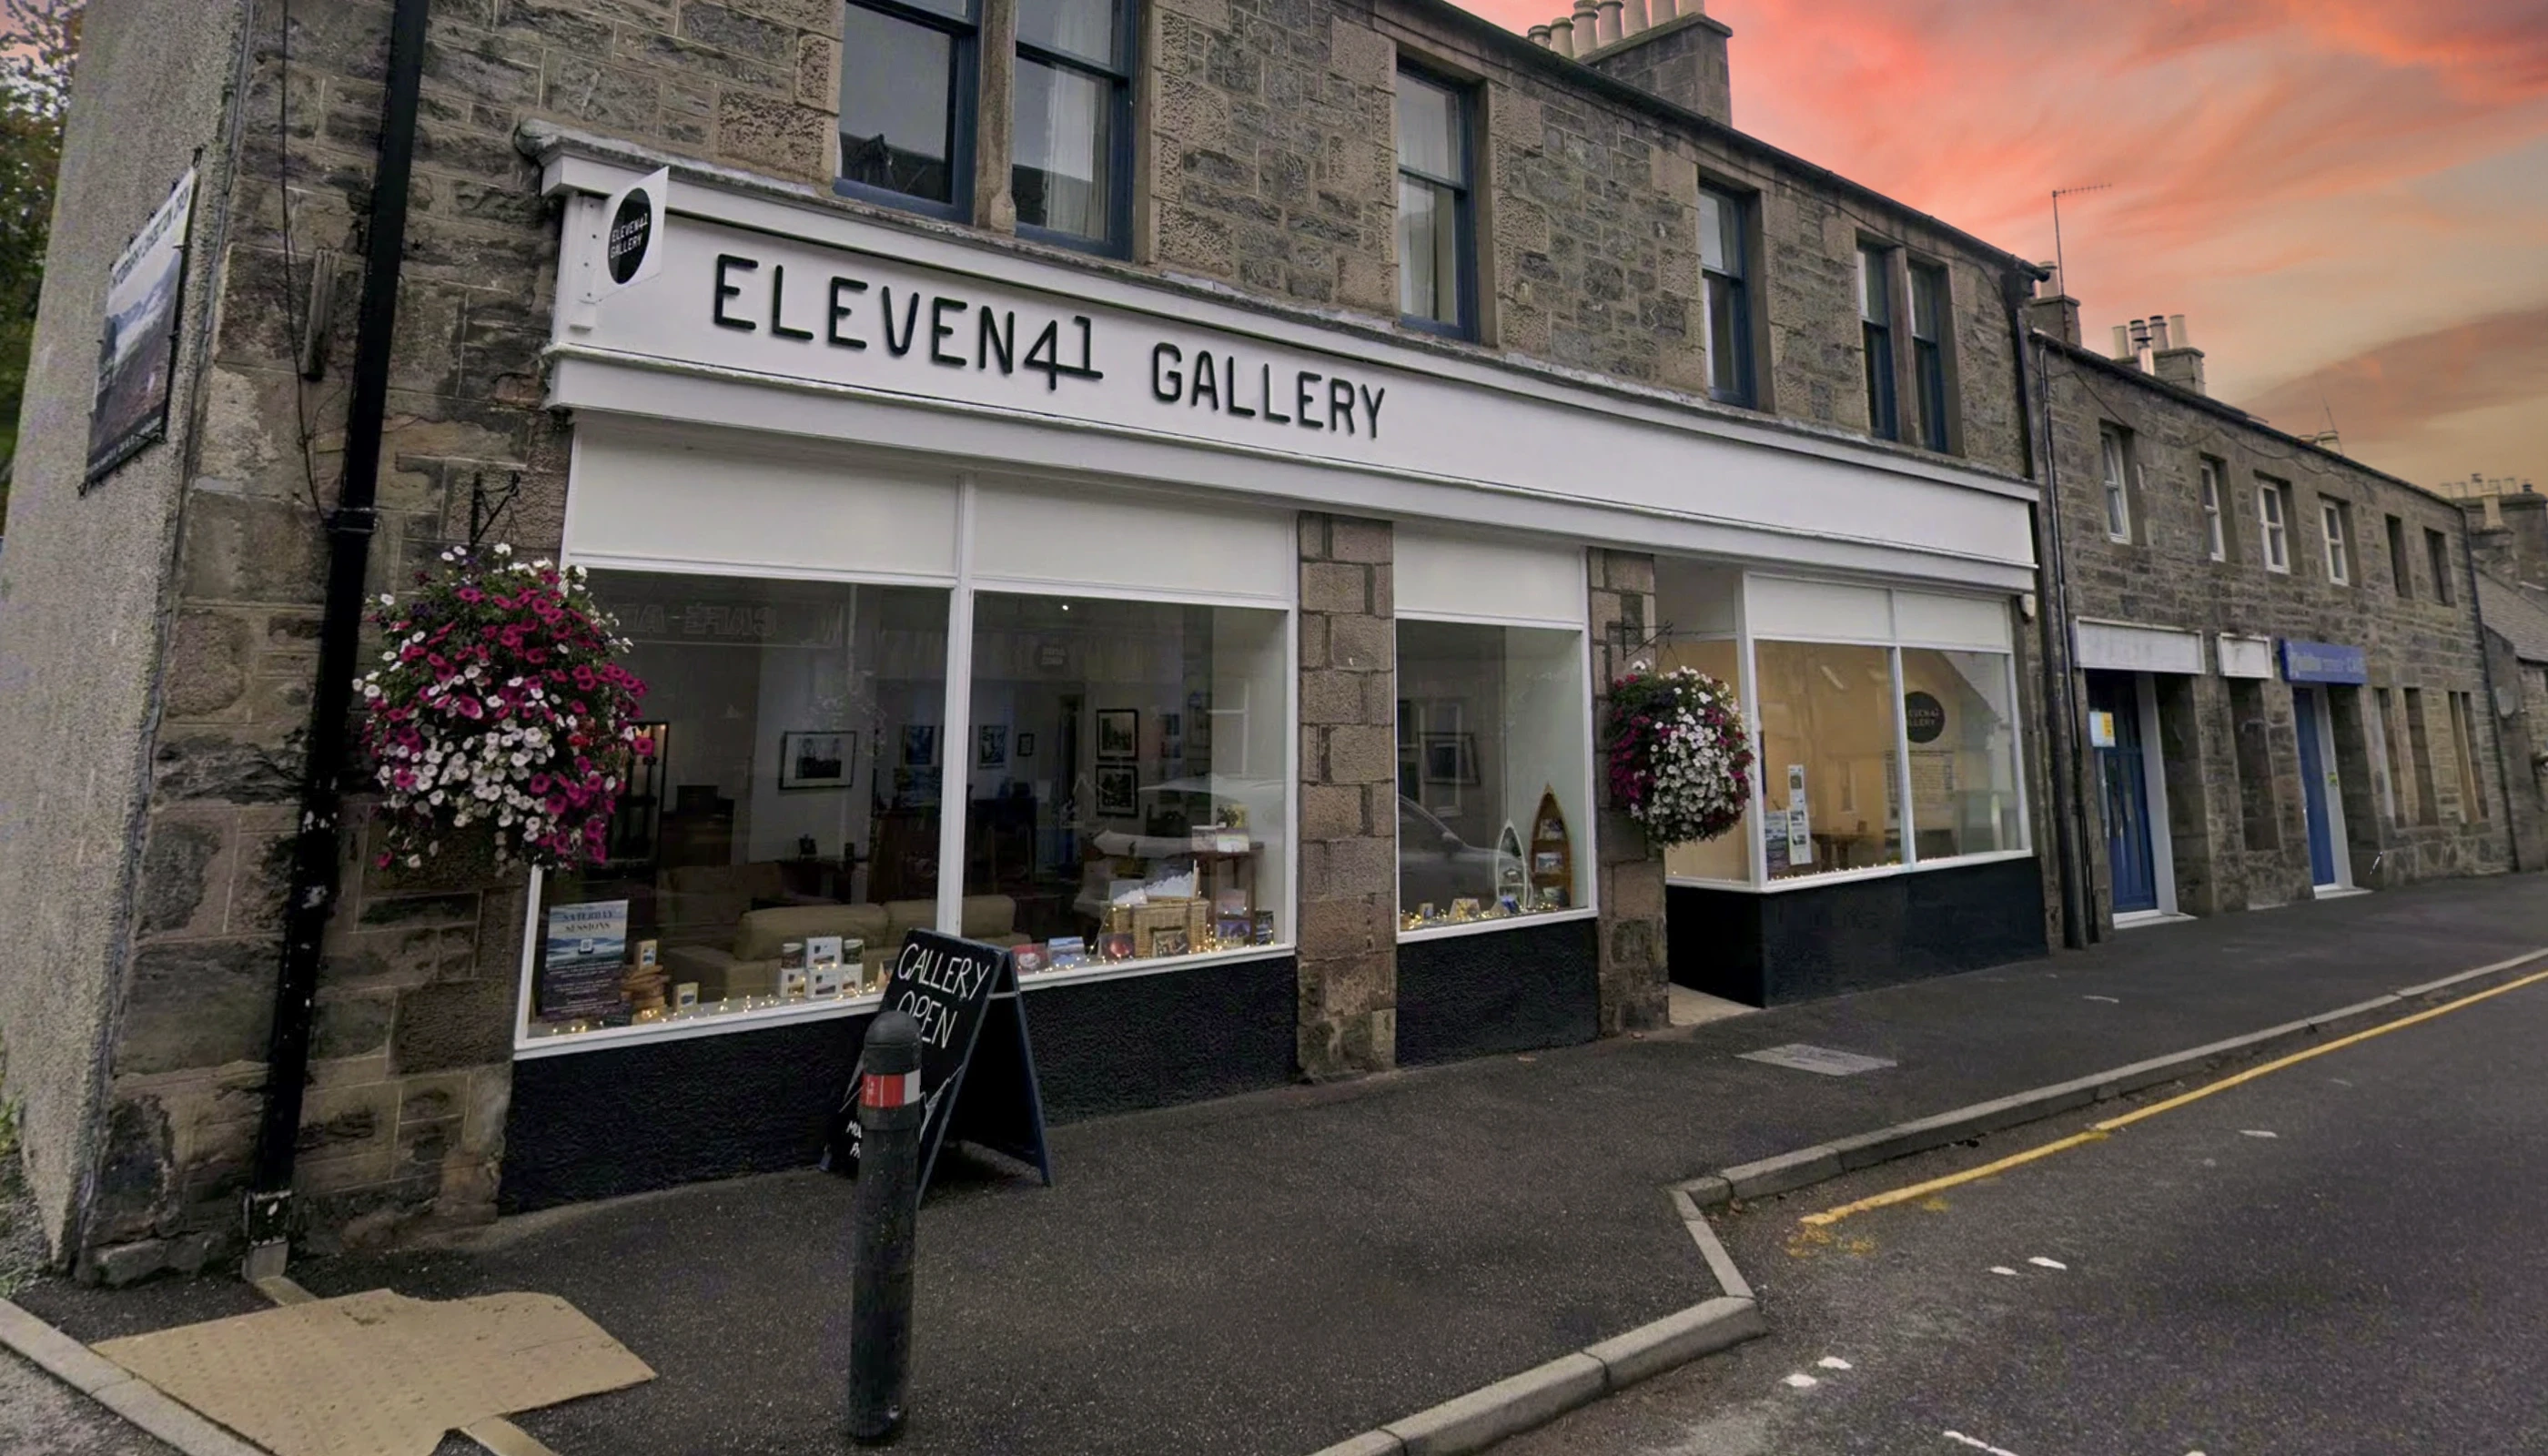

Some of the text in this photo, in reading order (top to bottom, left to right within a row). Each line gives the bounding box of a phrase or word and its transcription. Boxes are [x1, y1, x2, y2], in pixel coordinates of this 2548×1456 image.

[609, 235, 642, 259] GALLERY
[611, 211, 649, 243] ELEVEN41
[713, 253, 1387, 439] ELEVEN41 GALLERY
[896, 989, 958, 1049] OPEN
